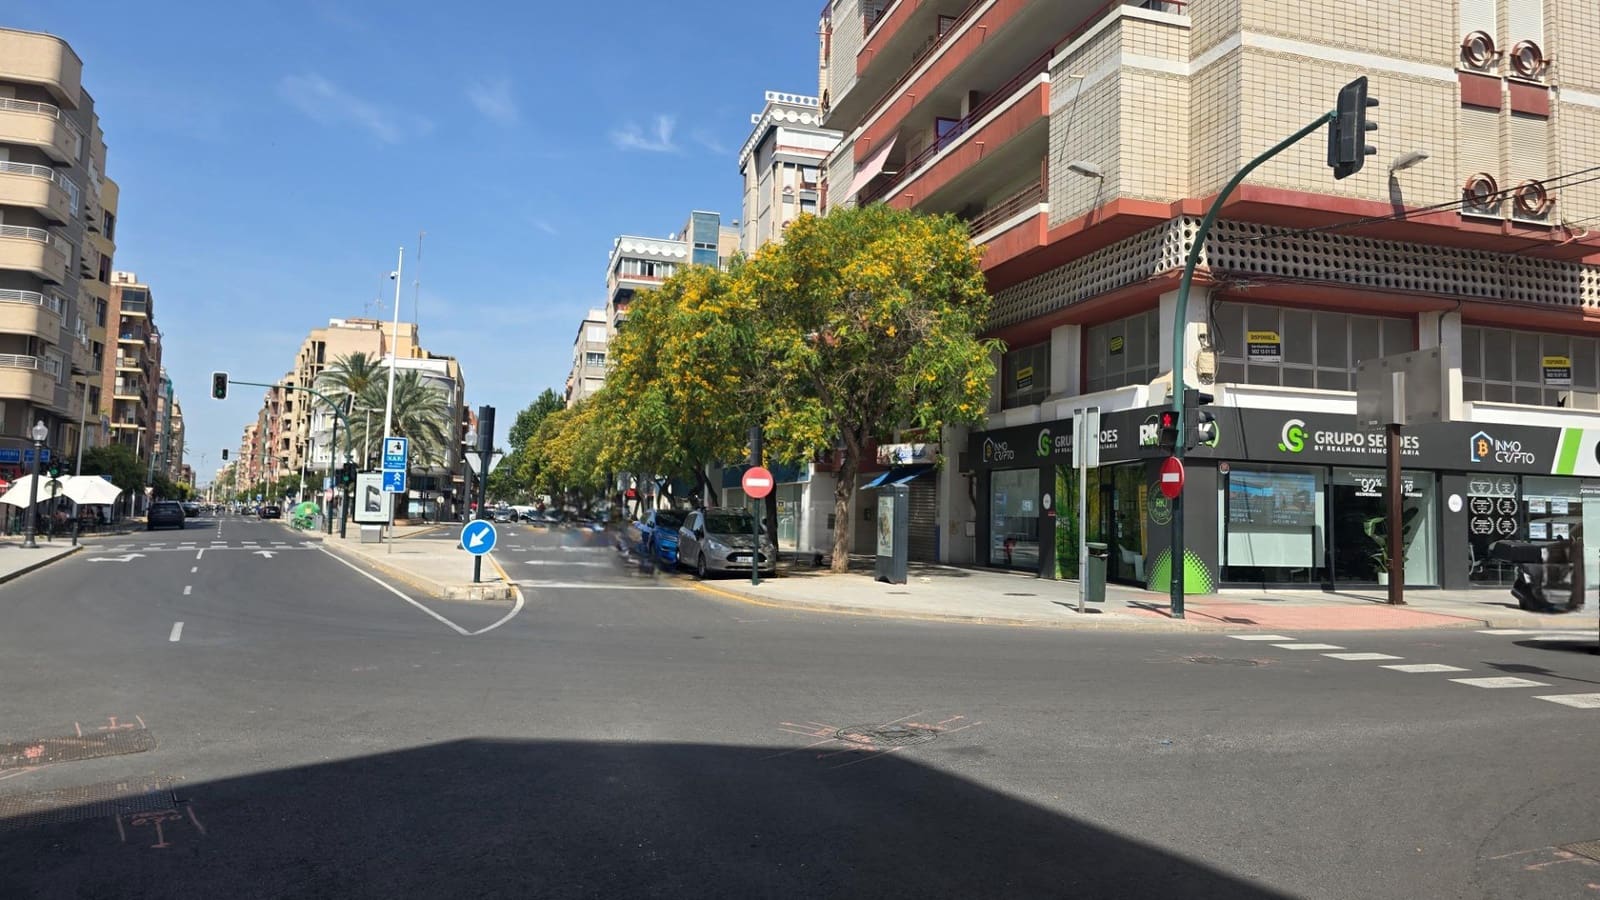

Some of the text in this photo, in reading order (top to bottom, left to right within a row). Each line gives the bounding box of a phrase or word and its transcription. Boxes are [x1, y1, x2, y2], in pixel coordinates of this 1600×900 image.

[1314, 431, 1365, 446] GRUPO
[1495, 439, 1521, 452] INMO
[1495, 451, 1536, 465] CRYPTO
